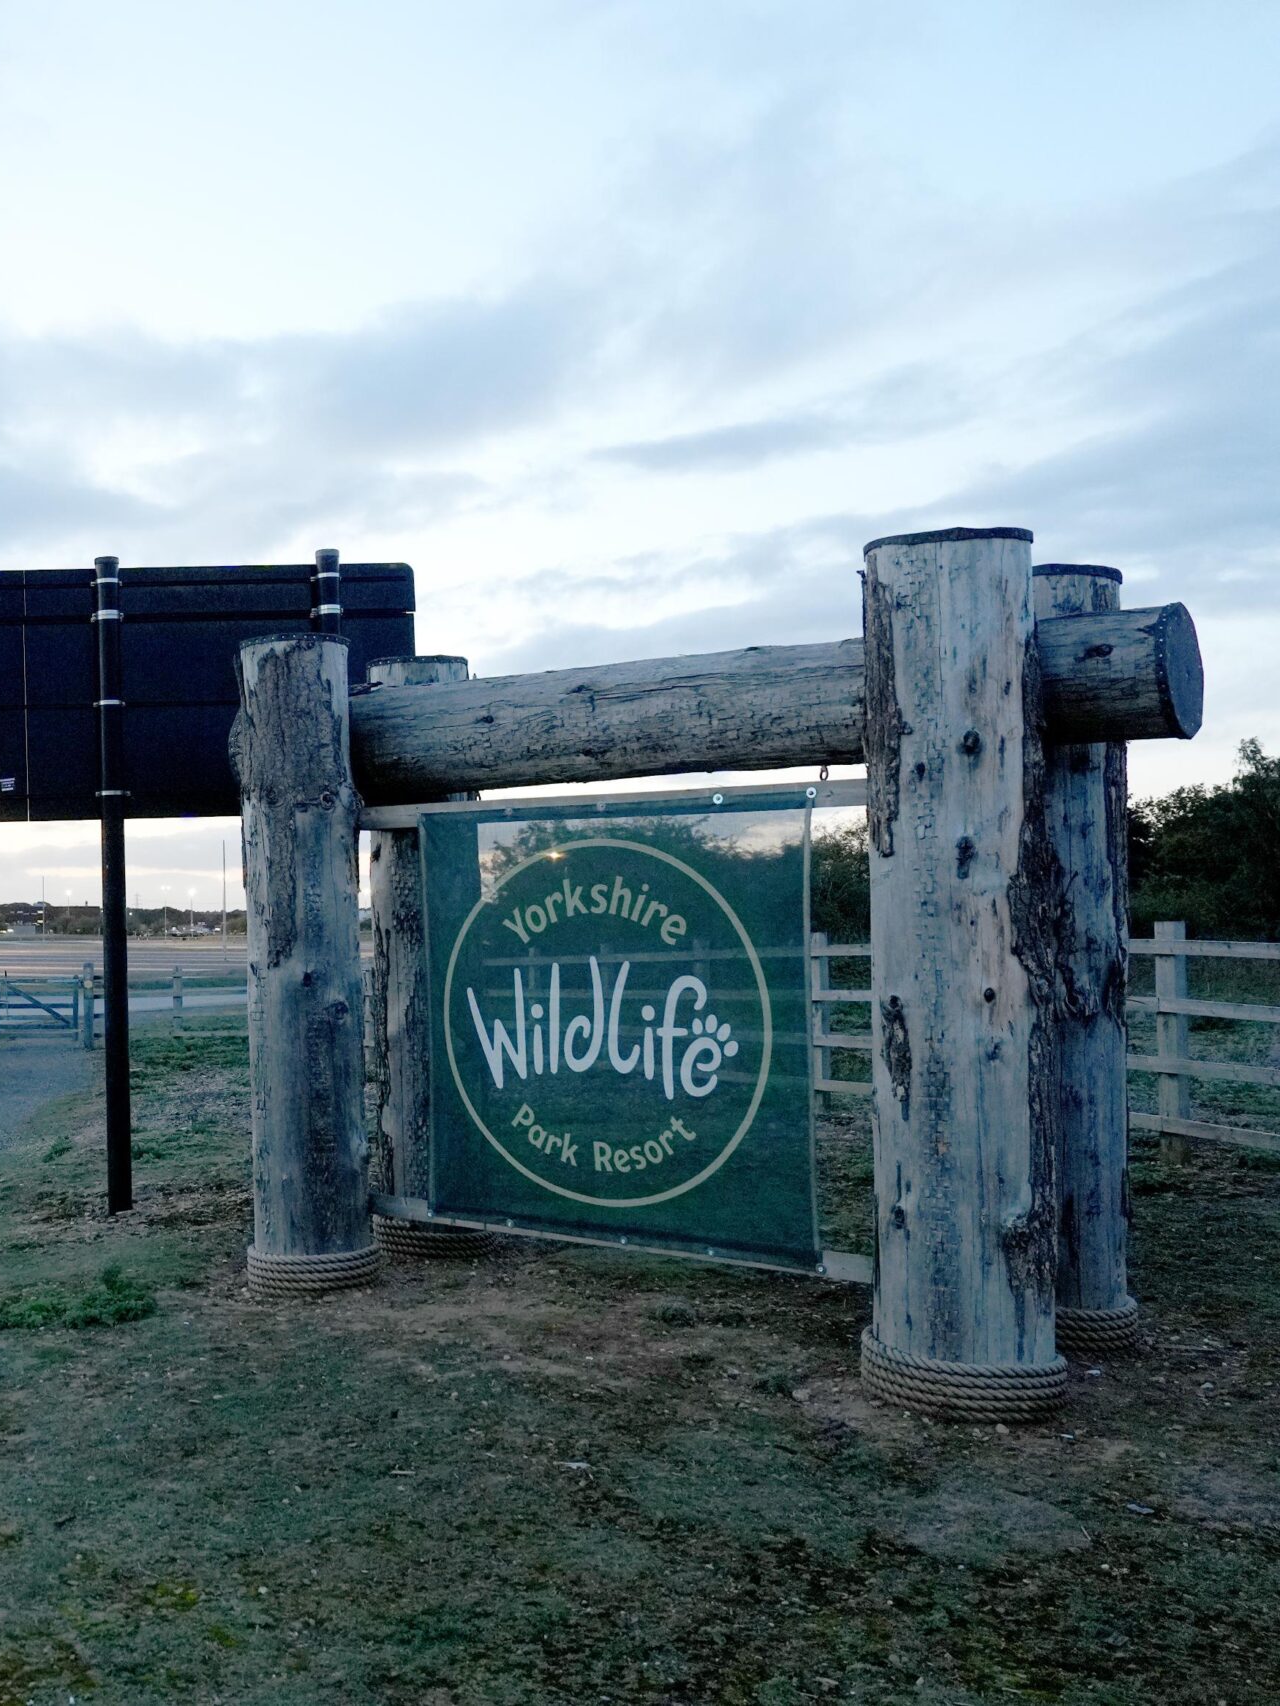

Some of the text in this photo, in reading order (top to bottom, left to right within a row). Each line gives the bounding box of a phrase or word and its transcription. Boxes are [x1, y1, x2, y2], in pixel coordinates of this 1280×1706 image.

[502, 876, 687, 946] Yorkshire
[511, 1103, 697, 1174] Park Resort
